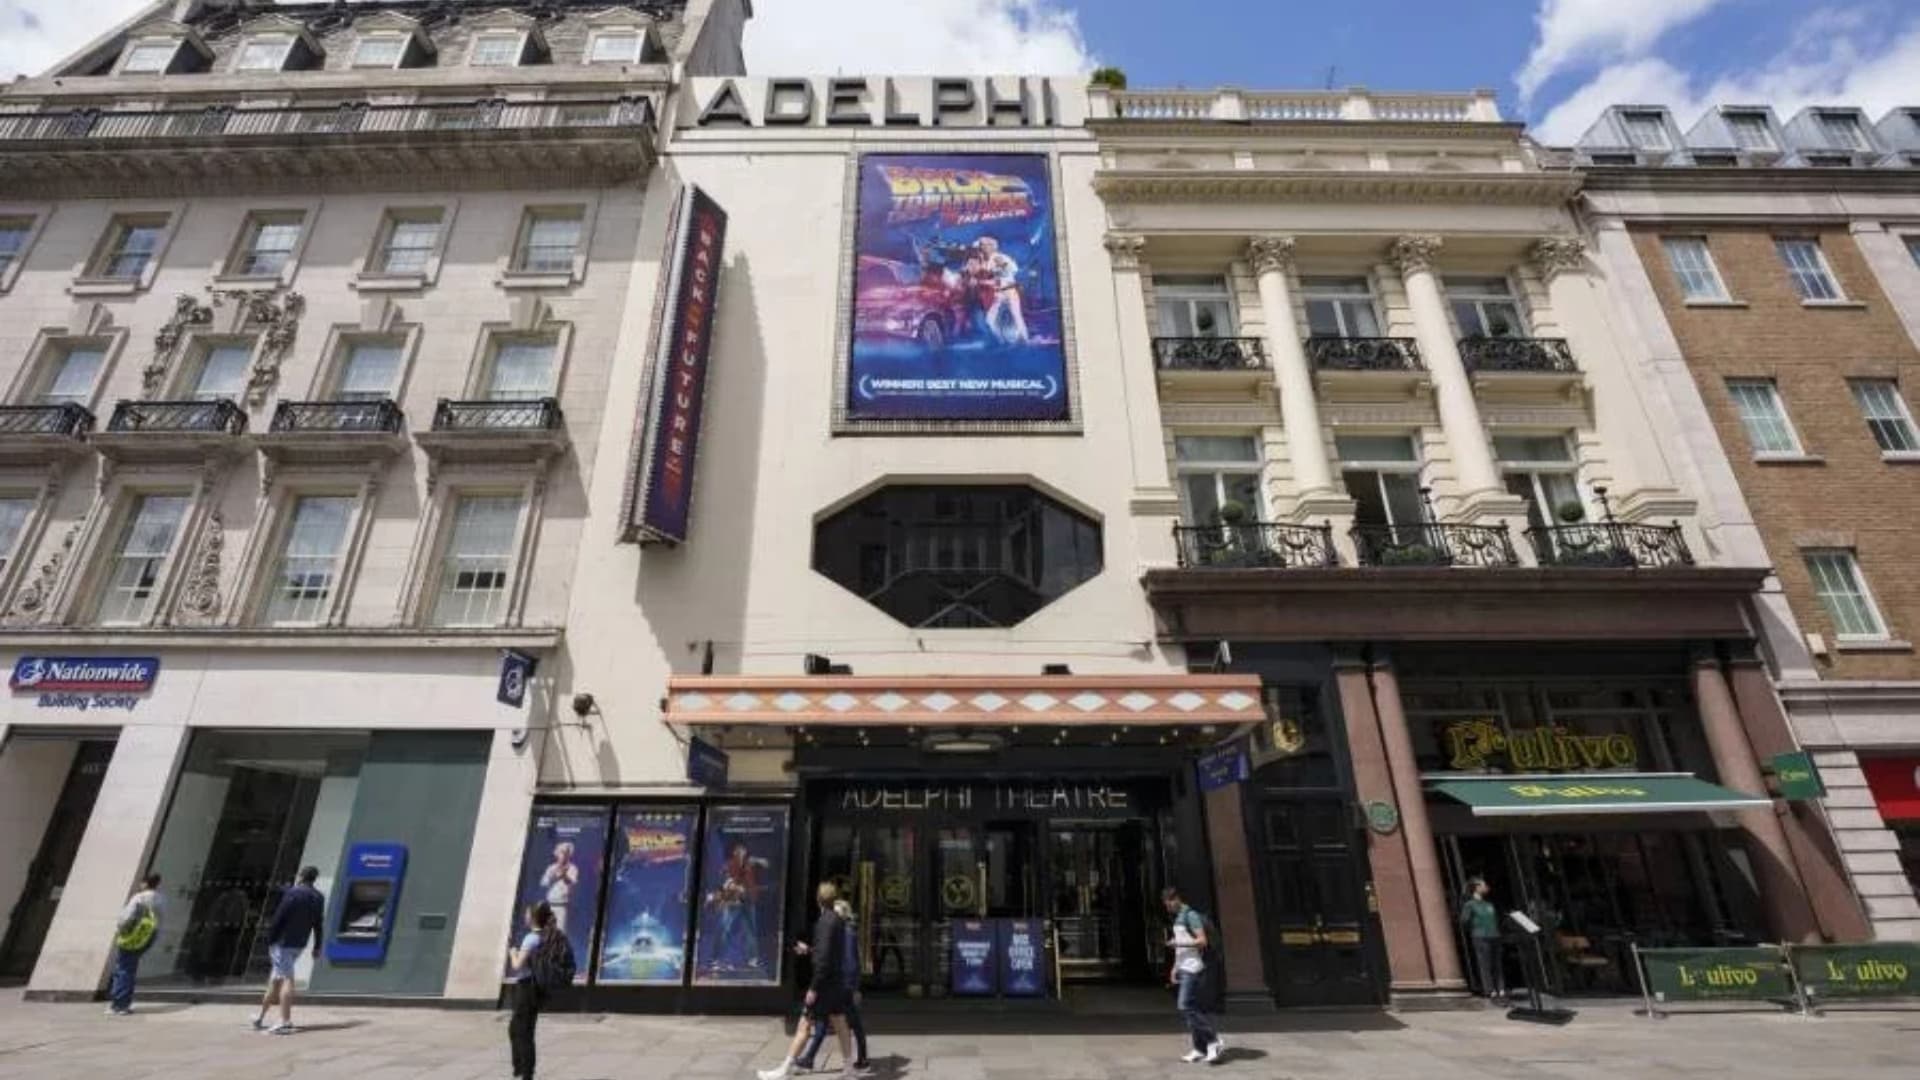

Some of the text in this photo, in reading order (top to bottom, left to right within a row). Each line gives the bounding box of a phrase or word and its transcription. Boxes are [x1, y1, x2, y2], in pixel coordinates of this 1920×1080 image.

[697, 77, 1053, 127] ADELPHI
[926, 378, 956, 390] BEST
[959, 378, 989, 390] NEW
[991, 378, 1046, 390] MUSICAL
[46, 661, 149, 682] Nationwide
[37, 692, 140, 712] Building Society
[842, 785, 1128, 809] ADELPHI THEATRE
